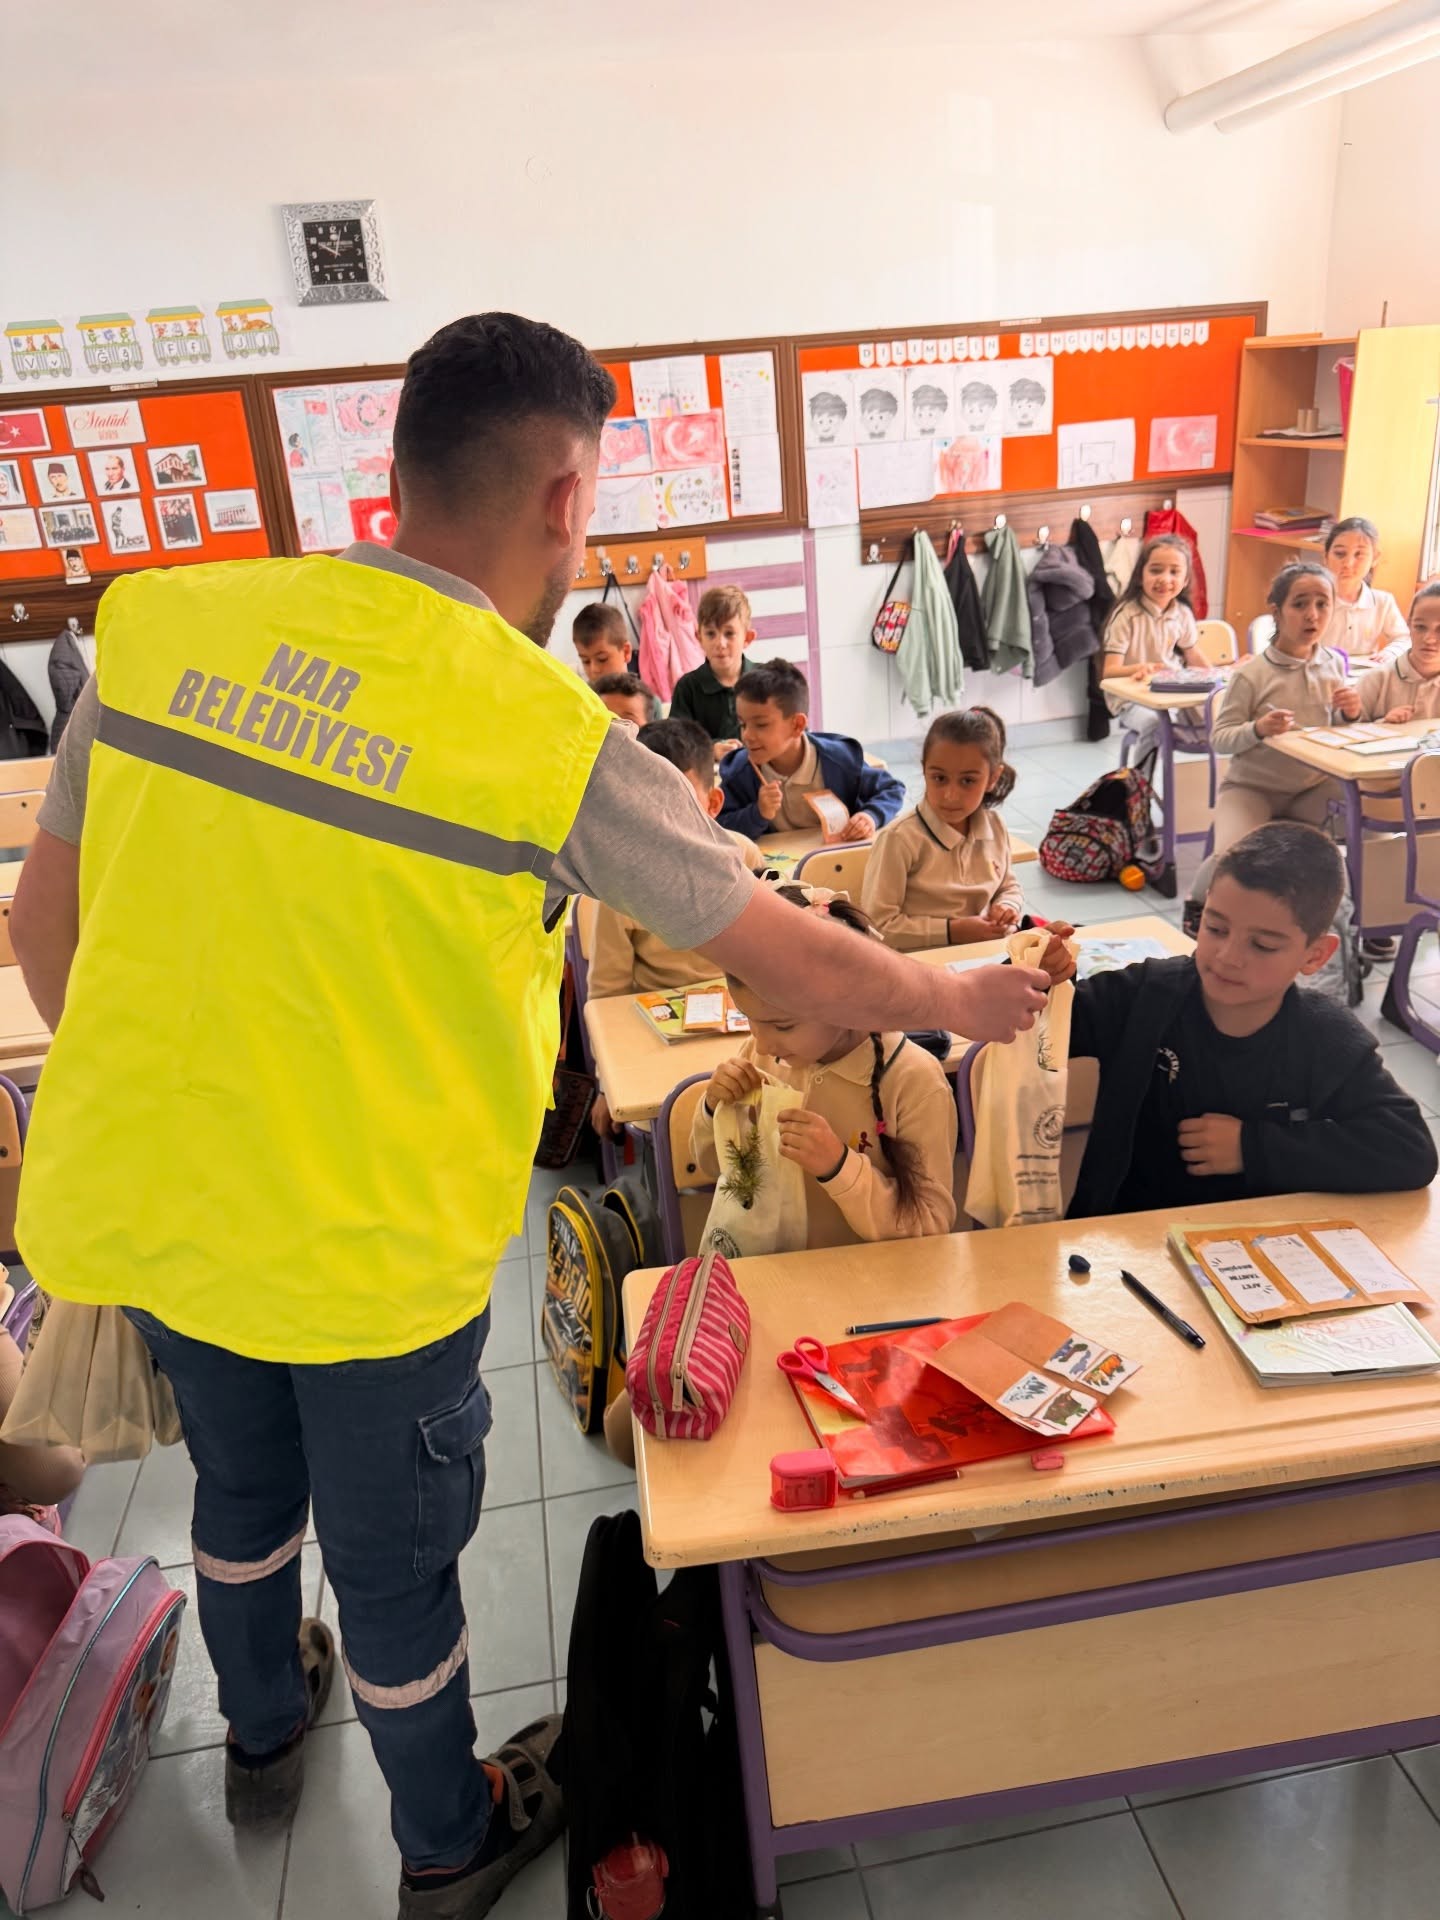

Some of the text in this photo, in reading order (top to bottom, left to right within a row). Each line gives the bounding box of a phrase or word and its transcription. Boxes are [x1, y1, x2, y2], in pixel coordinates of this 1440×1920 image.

[167, 342, 197, 354] F f
[25, 358, 35, 368] V
[73, 408, 129, 430] Atatürk
[260, 642, 361, 713] NAR
[168, 668, 413, 794] BELEDİYESİ
